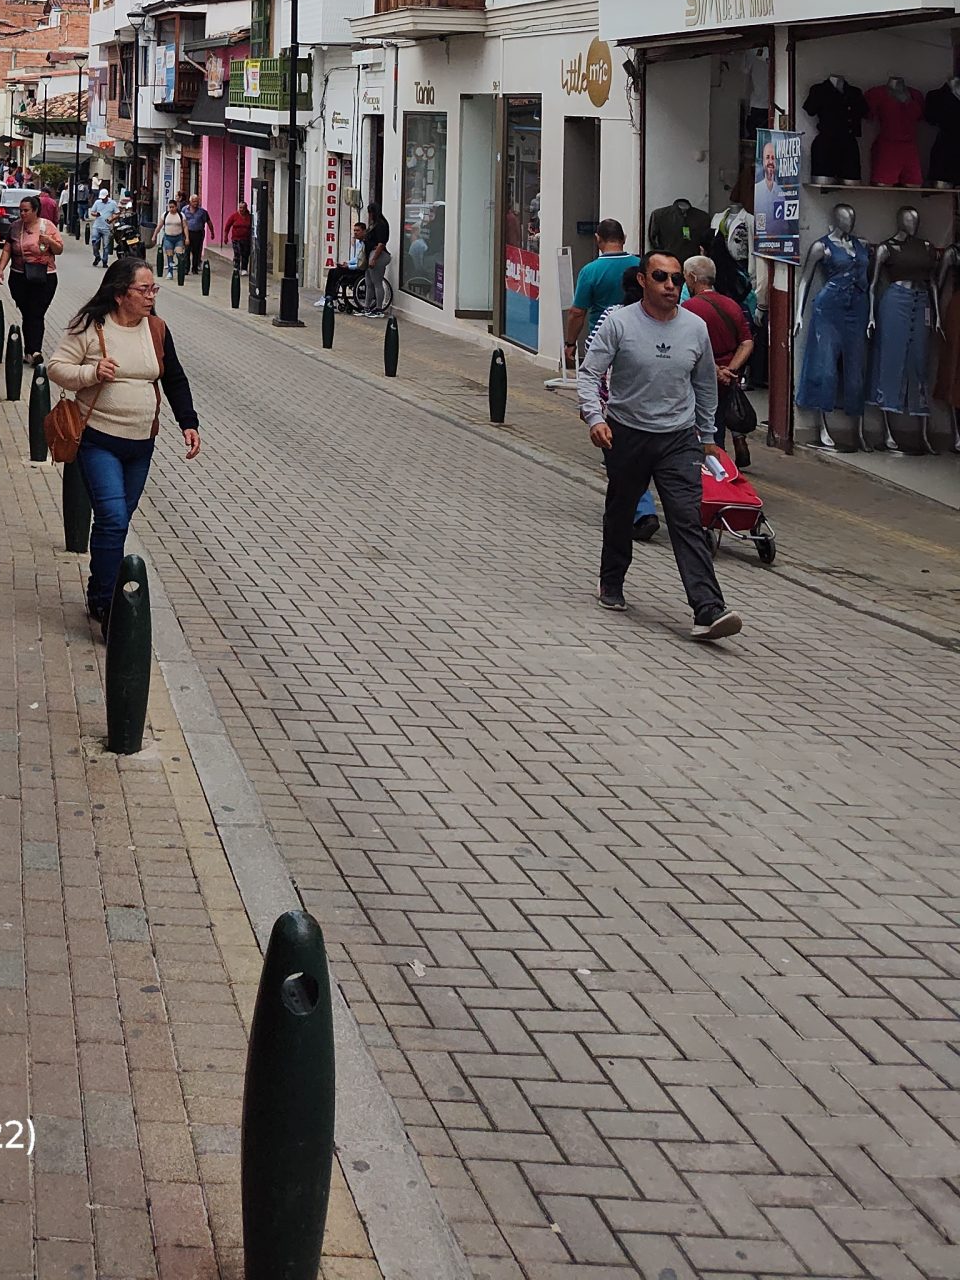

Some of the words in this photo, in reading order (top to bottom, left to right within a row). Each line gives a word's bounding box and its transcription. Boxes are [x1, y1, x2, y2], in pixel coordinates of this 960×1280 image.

[589, 59, 608, 85] mic
[414, 79, 435, 105] Tania
[775, 136, 801, 159] WALTER
[778, 157, 799, 178] ARIAS
[325, 156, 338, 267] DROGUERIA
[786, 203, 798, 218] 57
